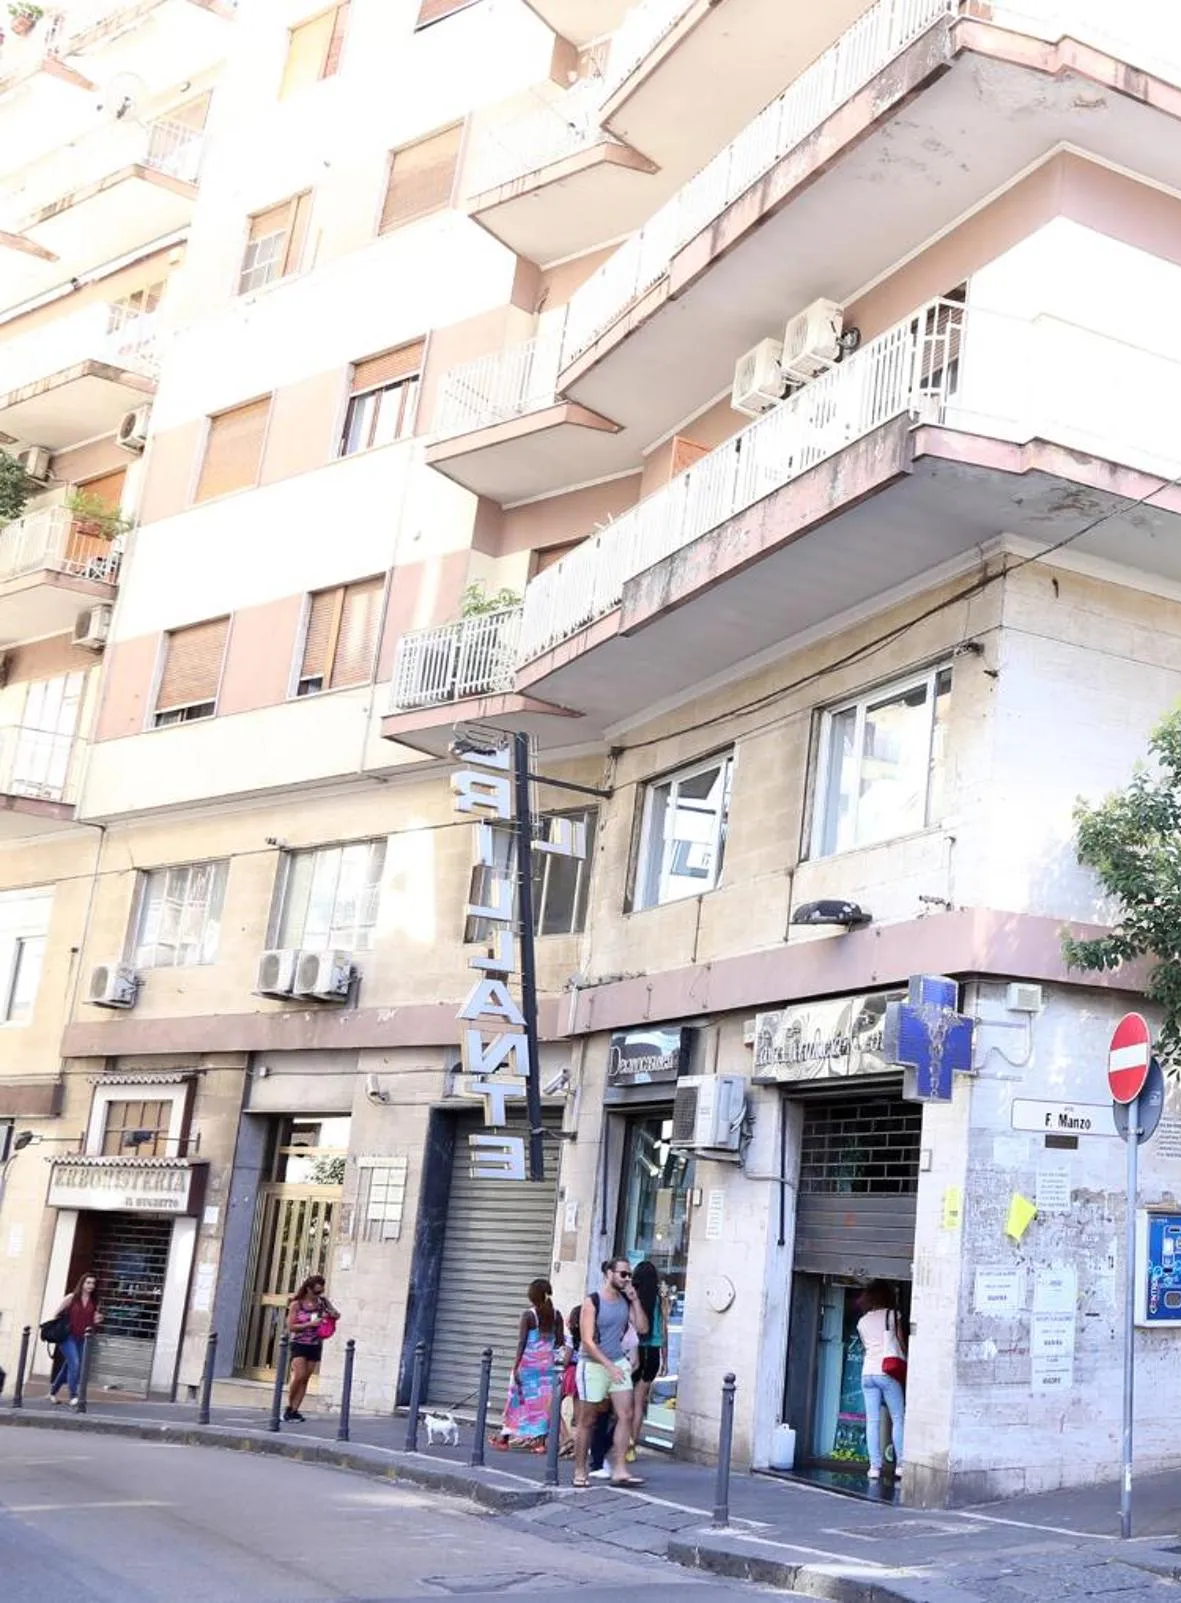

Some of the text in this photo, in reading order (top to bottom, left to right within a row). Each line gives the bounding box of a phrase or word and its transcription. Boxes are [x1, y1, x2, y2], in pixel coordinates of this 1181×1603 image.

[1045, 1112, 1092, 1131] F. Manzo
[54, 1166, 187, 1194] ERBORISTERIA
